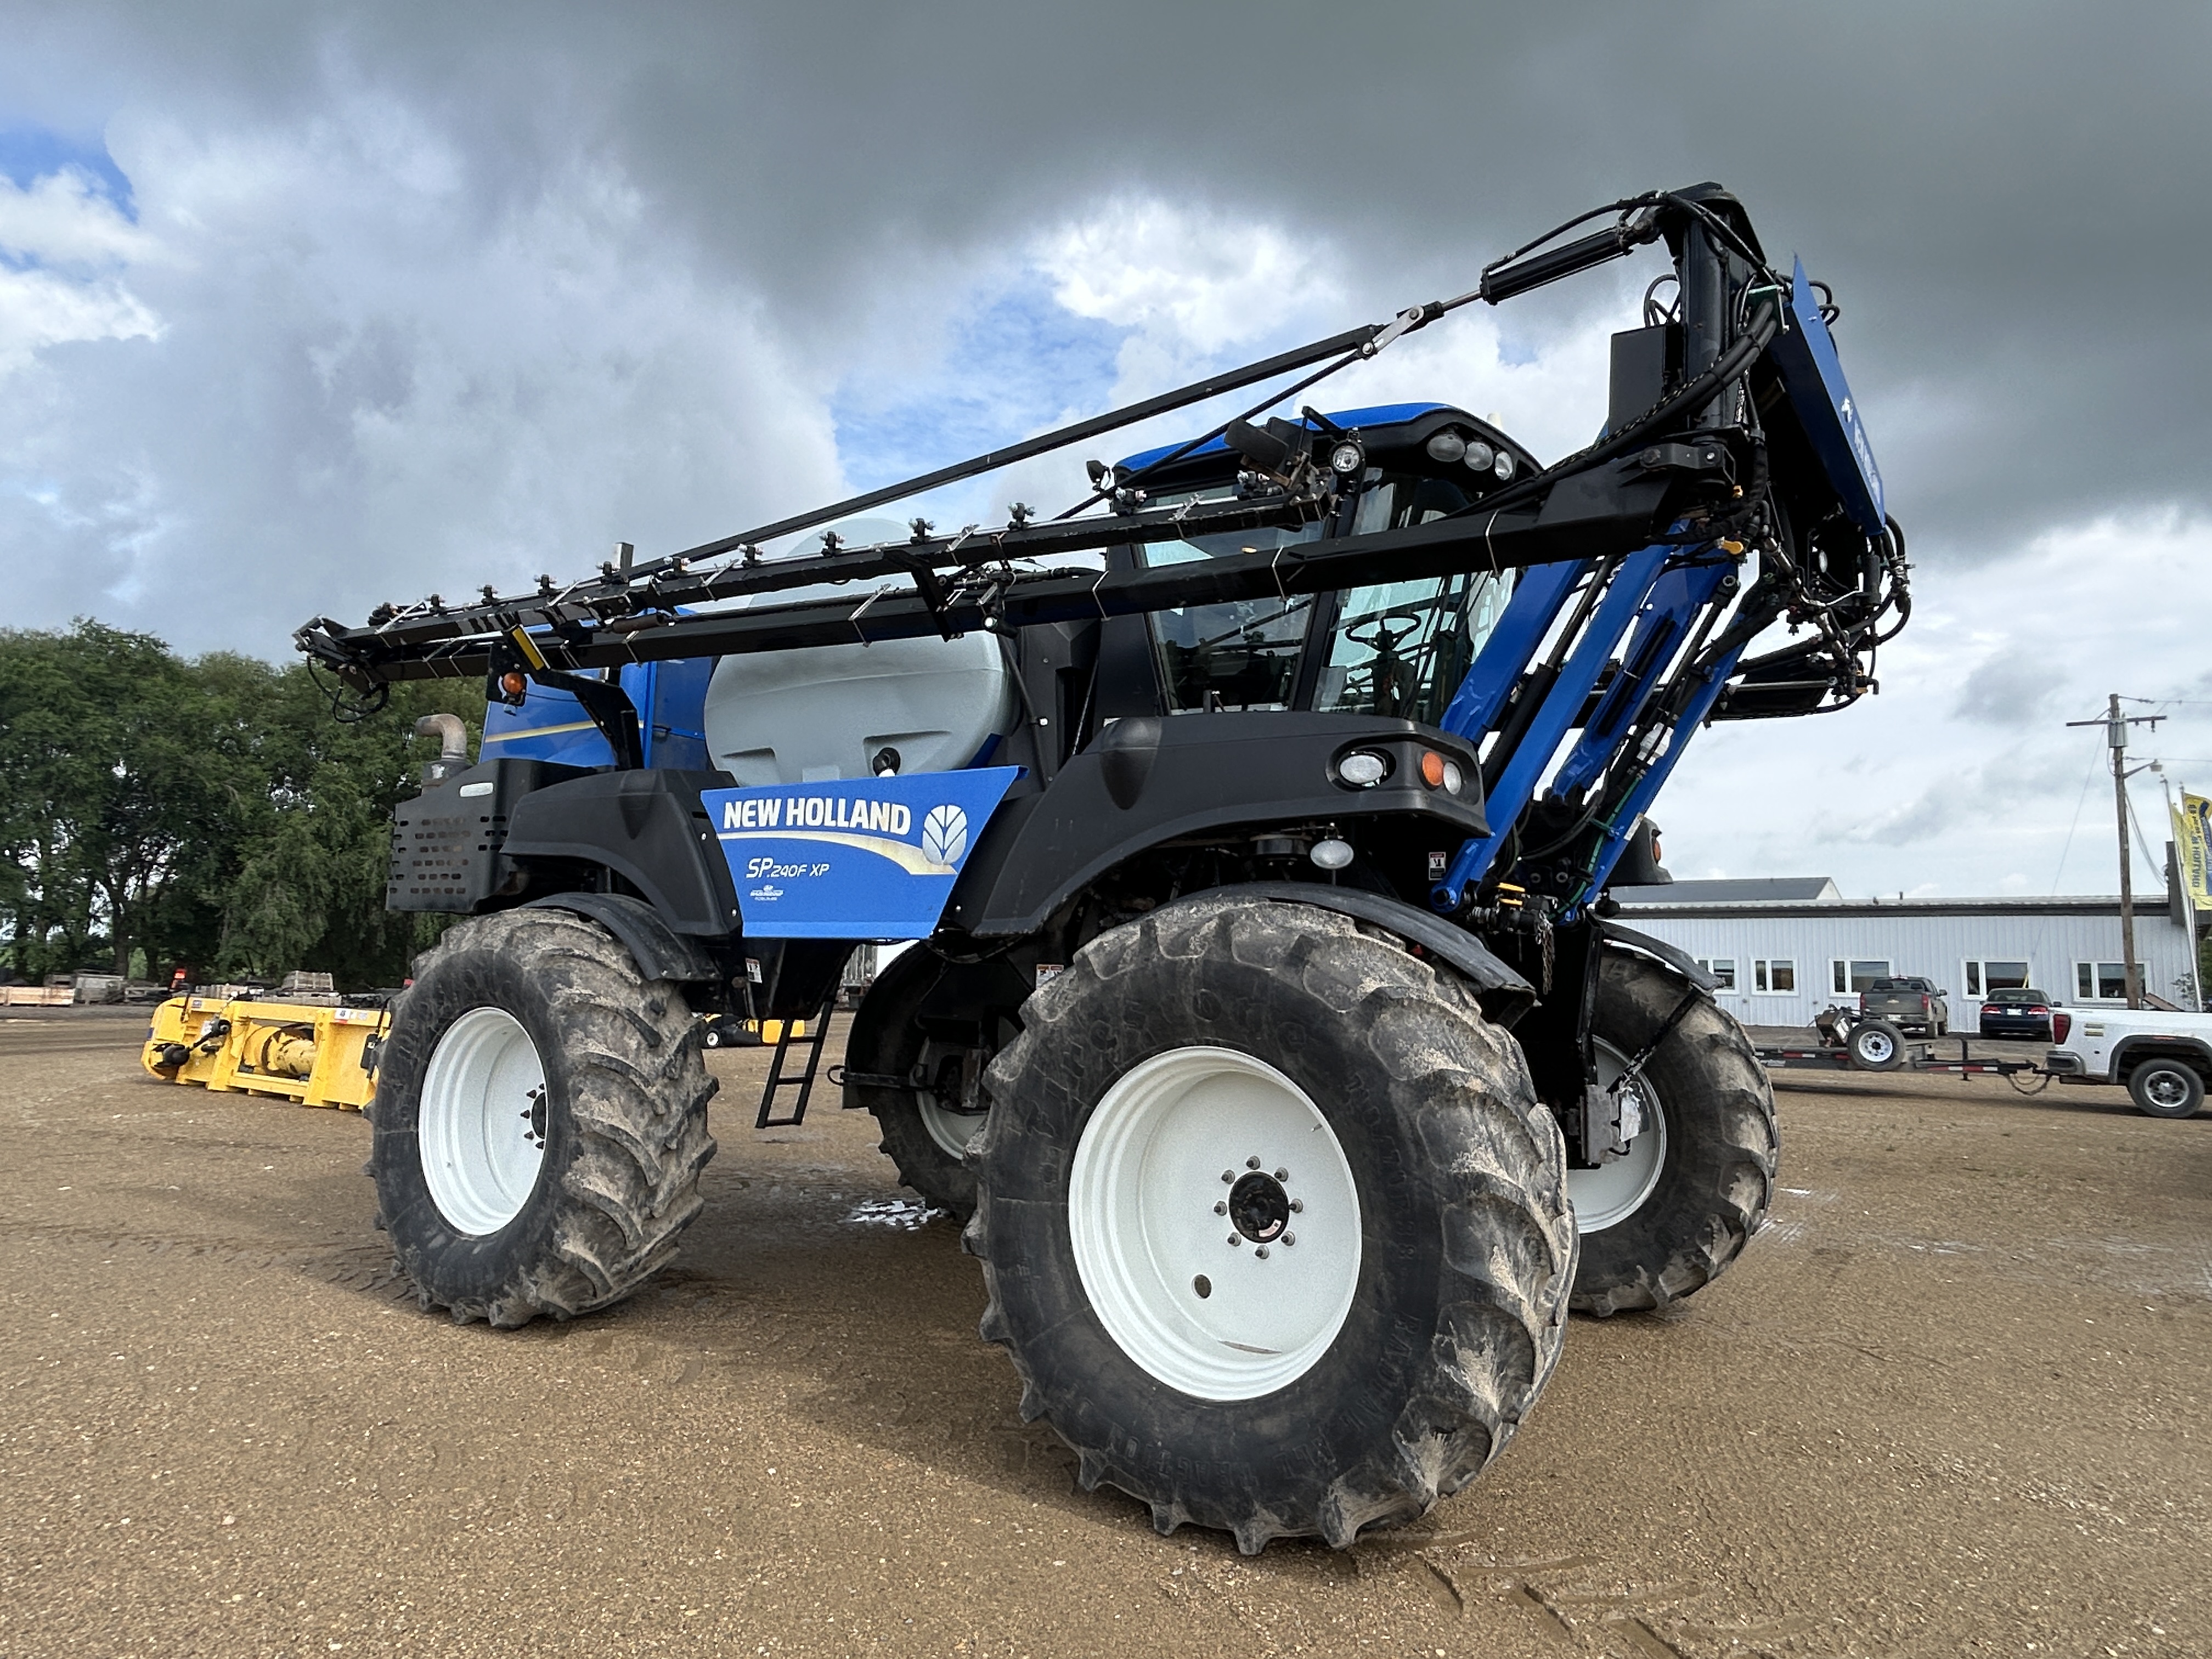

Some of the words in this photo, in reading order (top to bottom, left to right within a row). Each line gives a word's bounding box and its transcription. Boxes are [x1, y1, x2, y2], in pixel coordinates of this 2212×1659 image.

[724, 798, 782, 829] NEW
[786, 797, 911, 836] HOLLAND
[809, 863, 830, 877] XP
